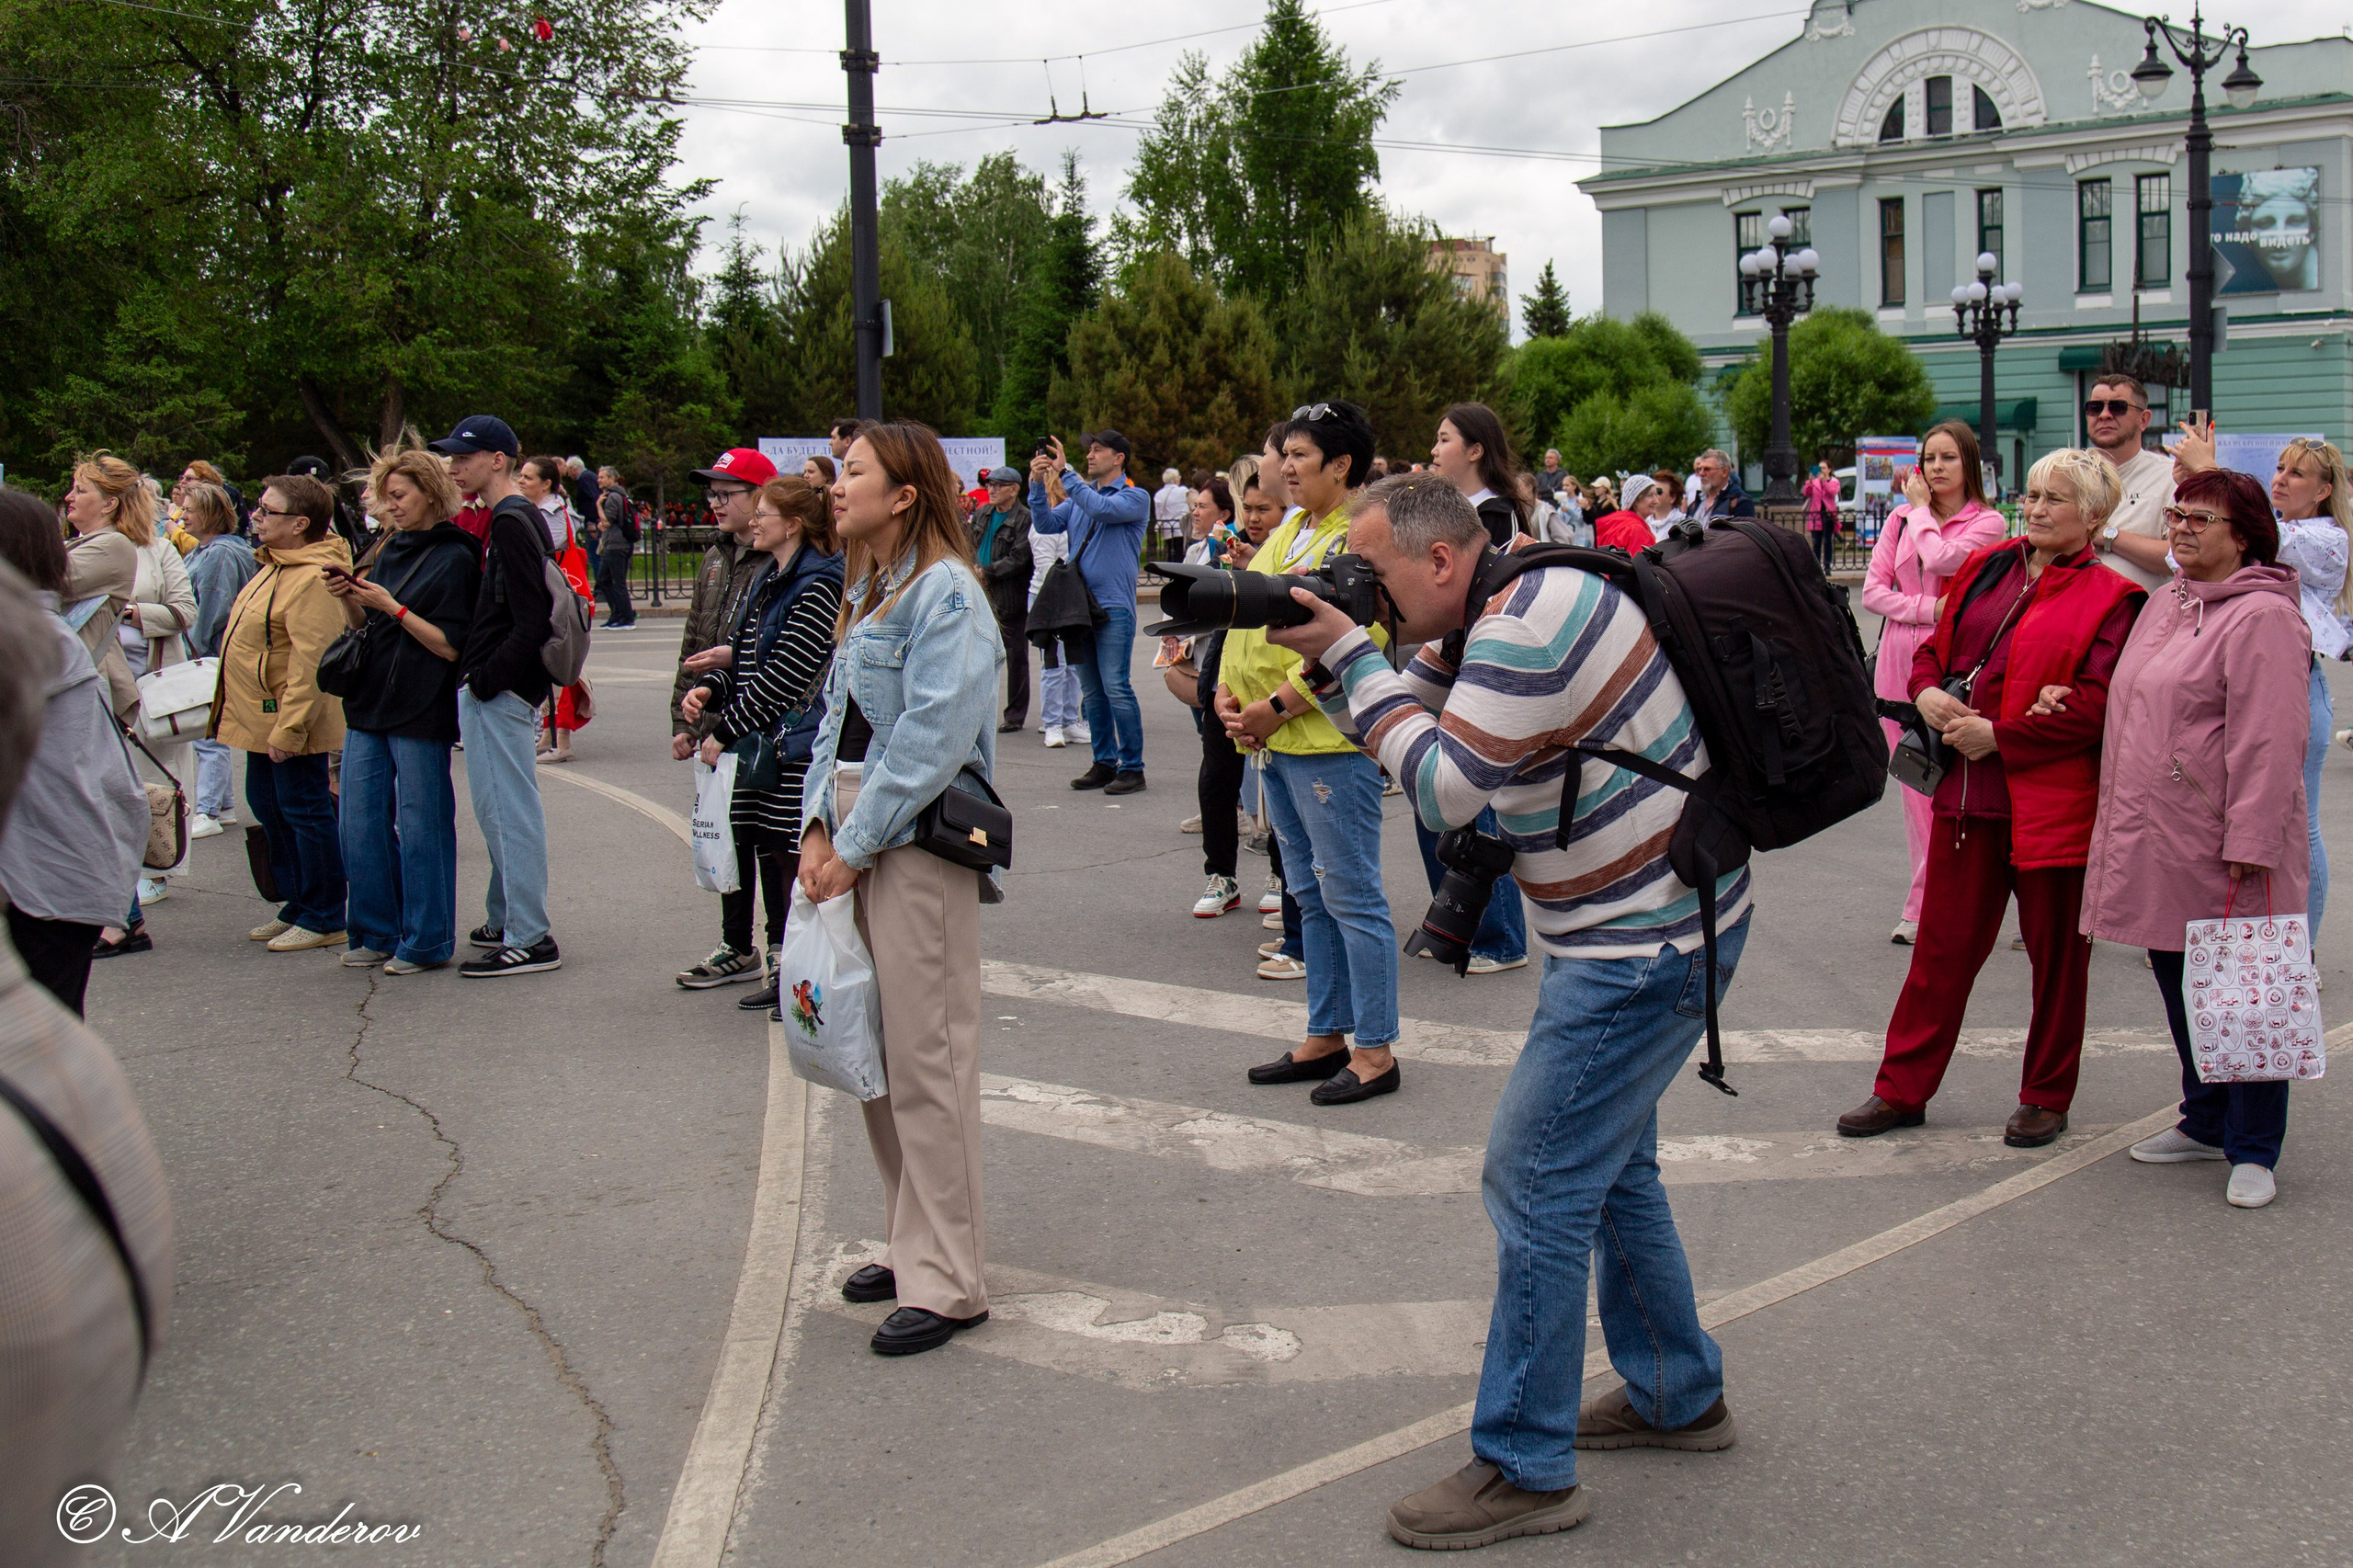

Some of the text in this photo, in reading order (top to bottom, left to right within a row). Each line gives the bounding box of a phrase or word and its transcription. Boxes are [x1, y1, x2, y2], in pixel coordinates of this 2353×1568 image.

[2225, 231, 2258, 244] надо
[2259, 234, 2311, 248] видеть
[788, 446, 817, 455] БУДЕТ
